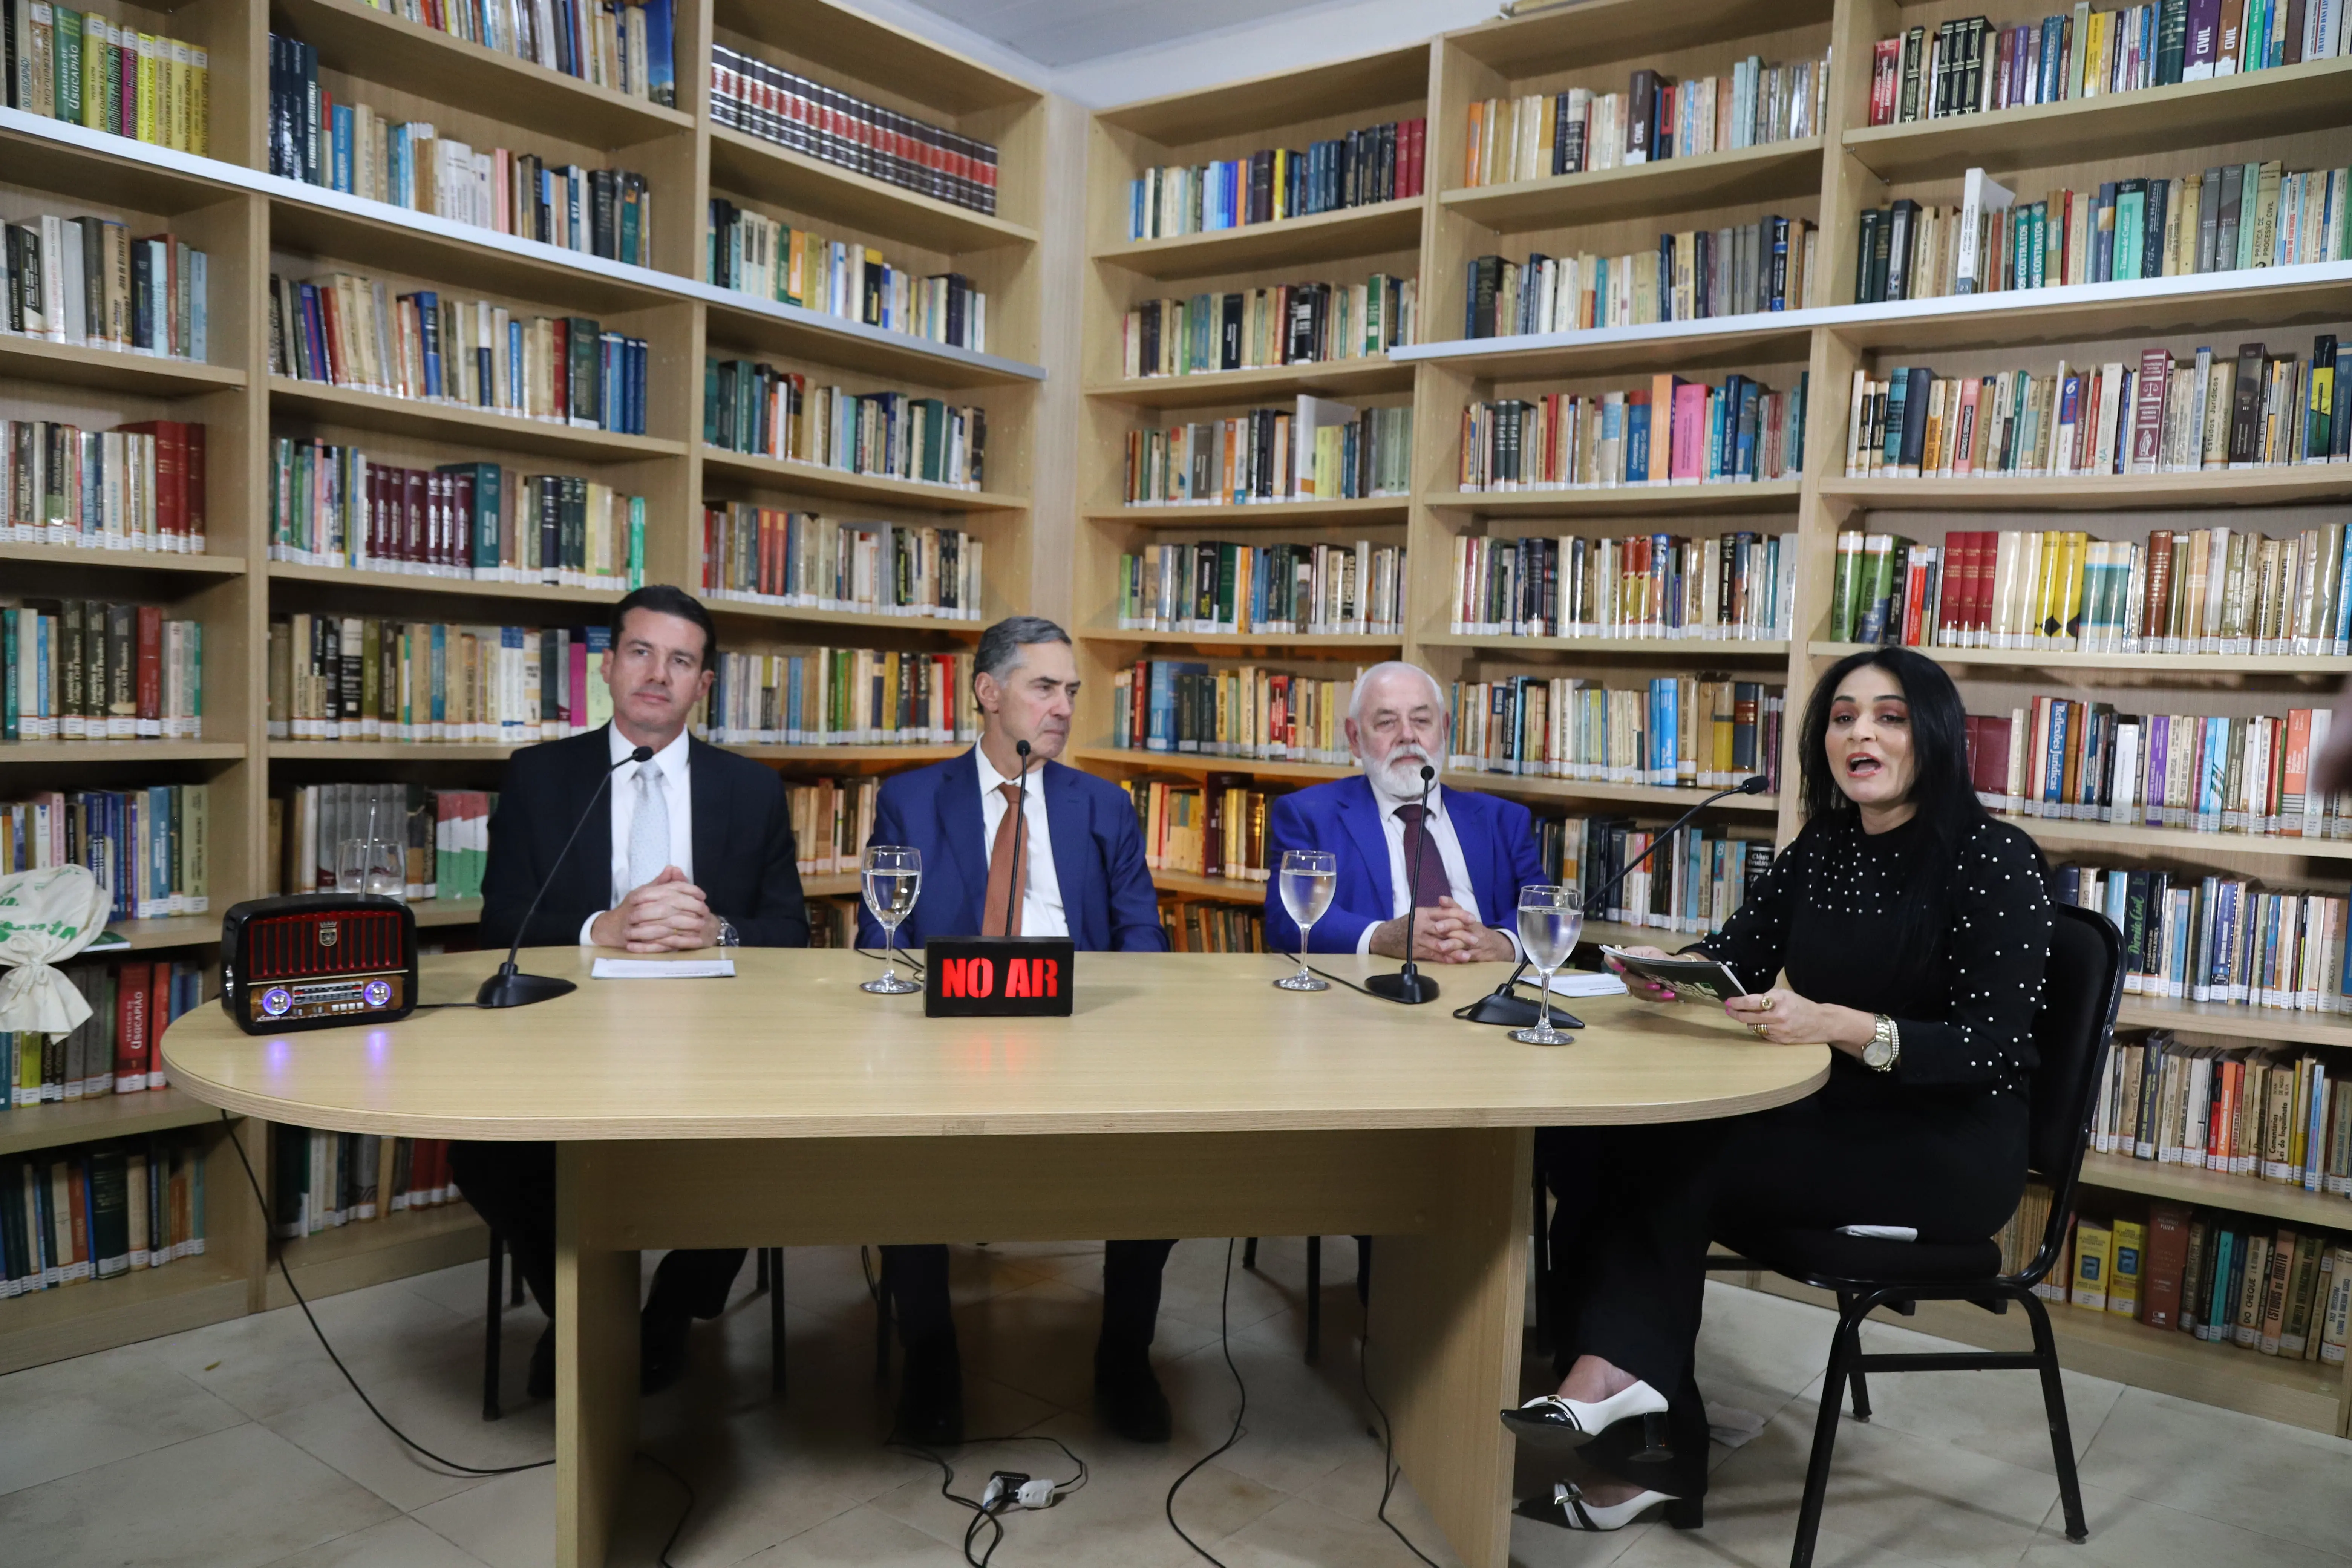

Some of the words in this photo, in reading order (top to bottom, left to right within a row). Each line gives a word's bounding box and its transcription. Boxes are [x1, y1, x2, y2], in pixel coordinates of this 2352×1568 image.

[61, 47, 68, 59] DE
[2197, 26, 2211, 55] CIVIL
[2224, 26, 2237, 50] CIVIL
[2317, 24, 2326, 53] TRATADO
[21, 98, 30, 108] DO
[2258, 217, 2264, 228] DE
[2018, 224, 2029, 276] CONTRATOS
[2033, 220, 2043, 273] CONTRATOS
[2255, 230, 2263, 257] PRÁTICA
[2263, 220, 2272, 257] PROCESSO
[2065, 381, 2078, 394] 6
[2210, 377, 2219, 414] Jurídicos
[2206, 419, 2215, 452] Estudos
[2053, 705, 2066, 749] Reflexões
[2050, 749, 2062, 790] Jurídicas
[1716, 843, 1725, 856] 8
[2129, 894, 2144, 921] Civil
[2127, 921, 2142, 955] Direito
[942, 957, 994, 998] NO
[1004, 958, 1058, 997] AR
[130, 991, 144, 1049] USUCAPIÃO
[2269, 1114, 2278, 1153] Comentários
[2278, 1102, 2288, 1137] Inquilinato
[2273, 1253, 2288, 1280] DIREITO
[2245, 1277, 2256, 1307] CHEQUE
[2275, 1282, 2283, 1290] DE
[2243, 1312, 2251, 1323] DO
[2267, 1290, 2282, 1321] ESTUDOS
